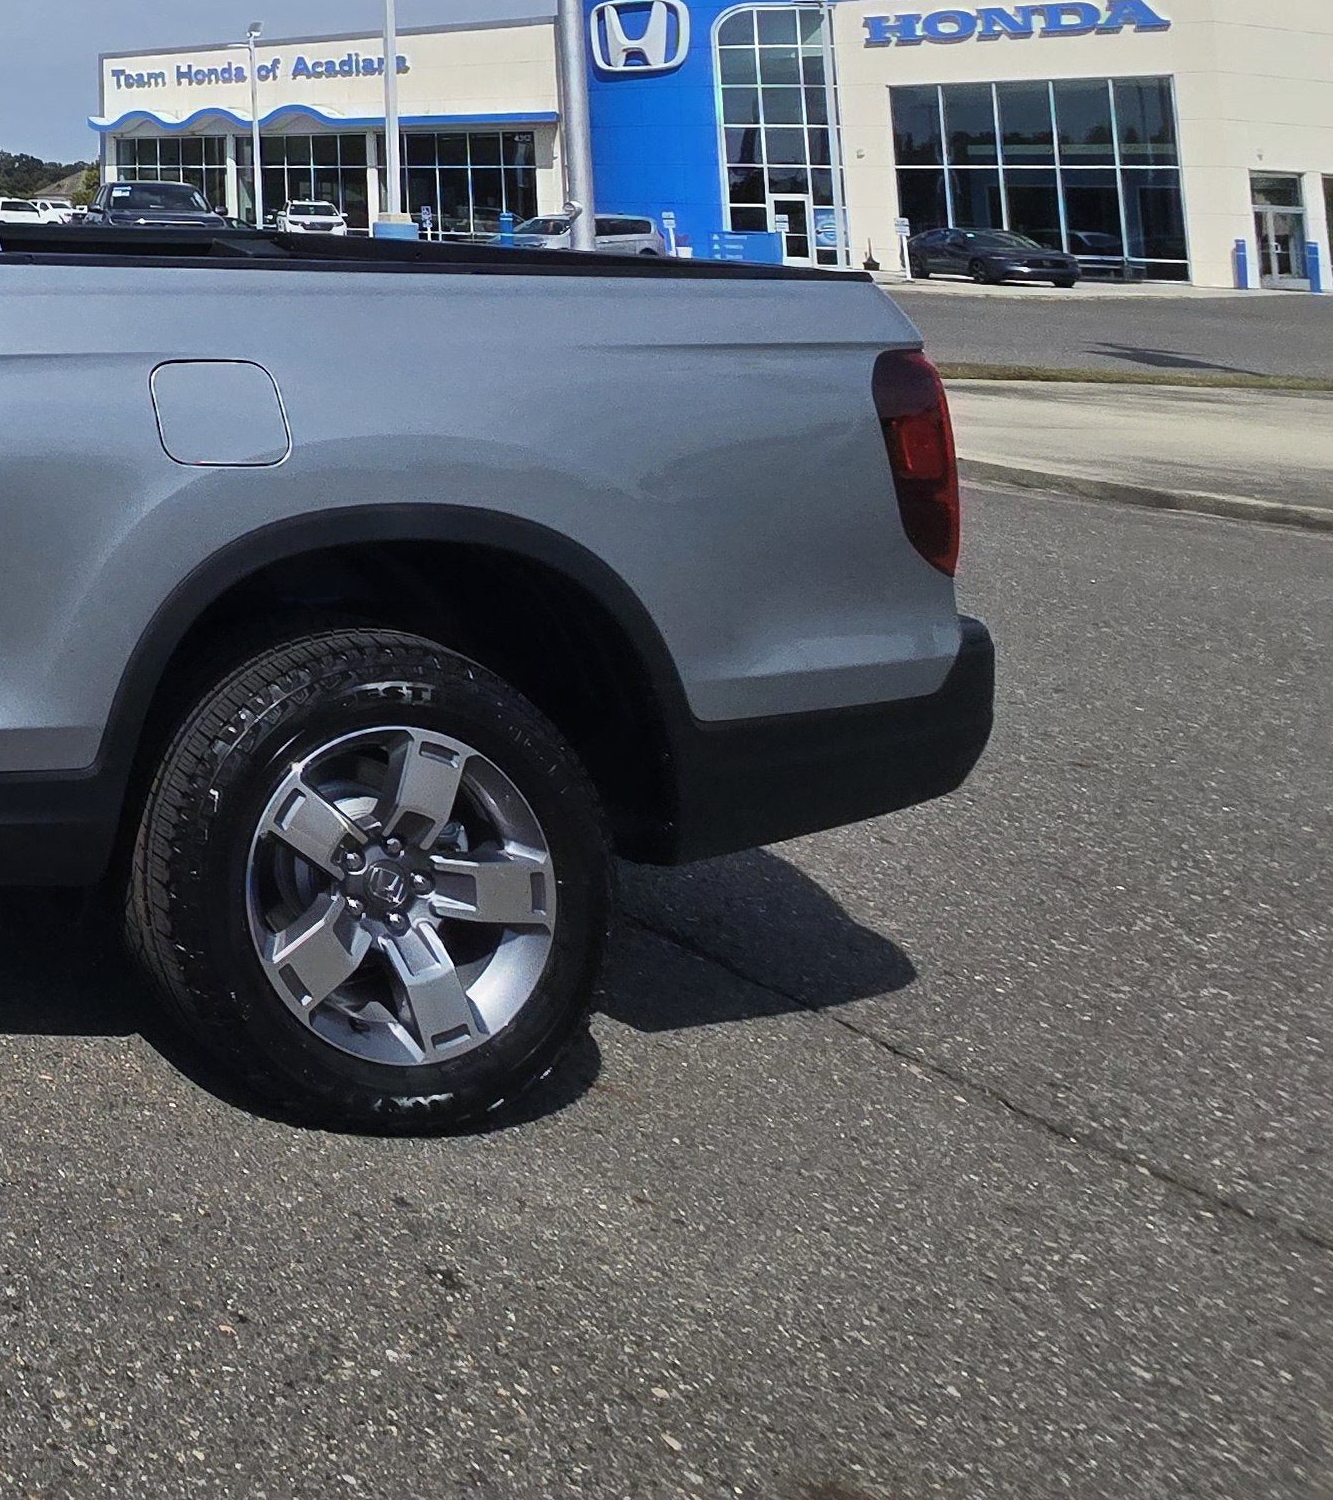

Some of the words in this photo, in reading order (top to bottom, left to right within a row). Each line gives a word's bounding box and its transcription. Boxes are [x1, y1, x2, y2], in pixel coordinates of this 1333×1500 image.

[111, 69, 167, 90] Team
[176, 61, 247, 86] Honda
[256, 57, 281, 82] of
